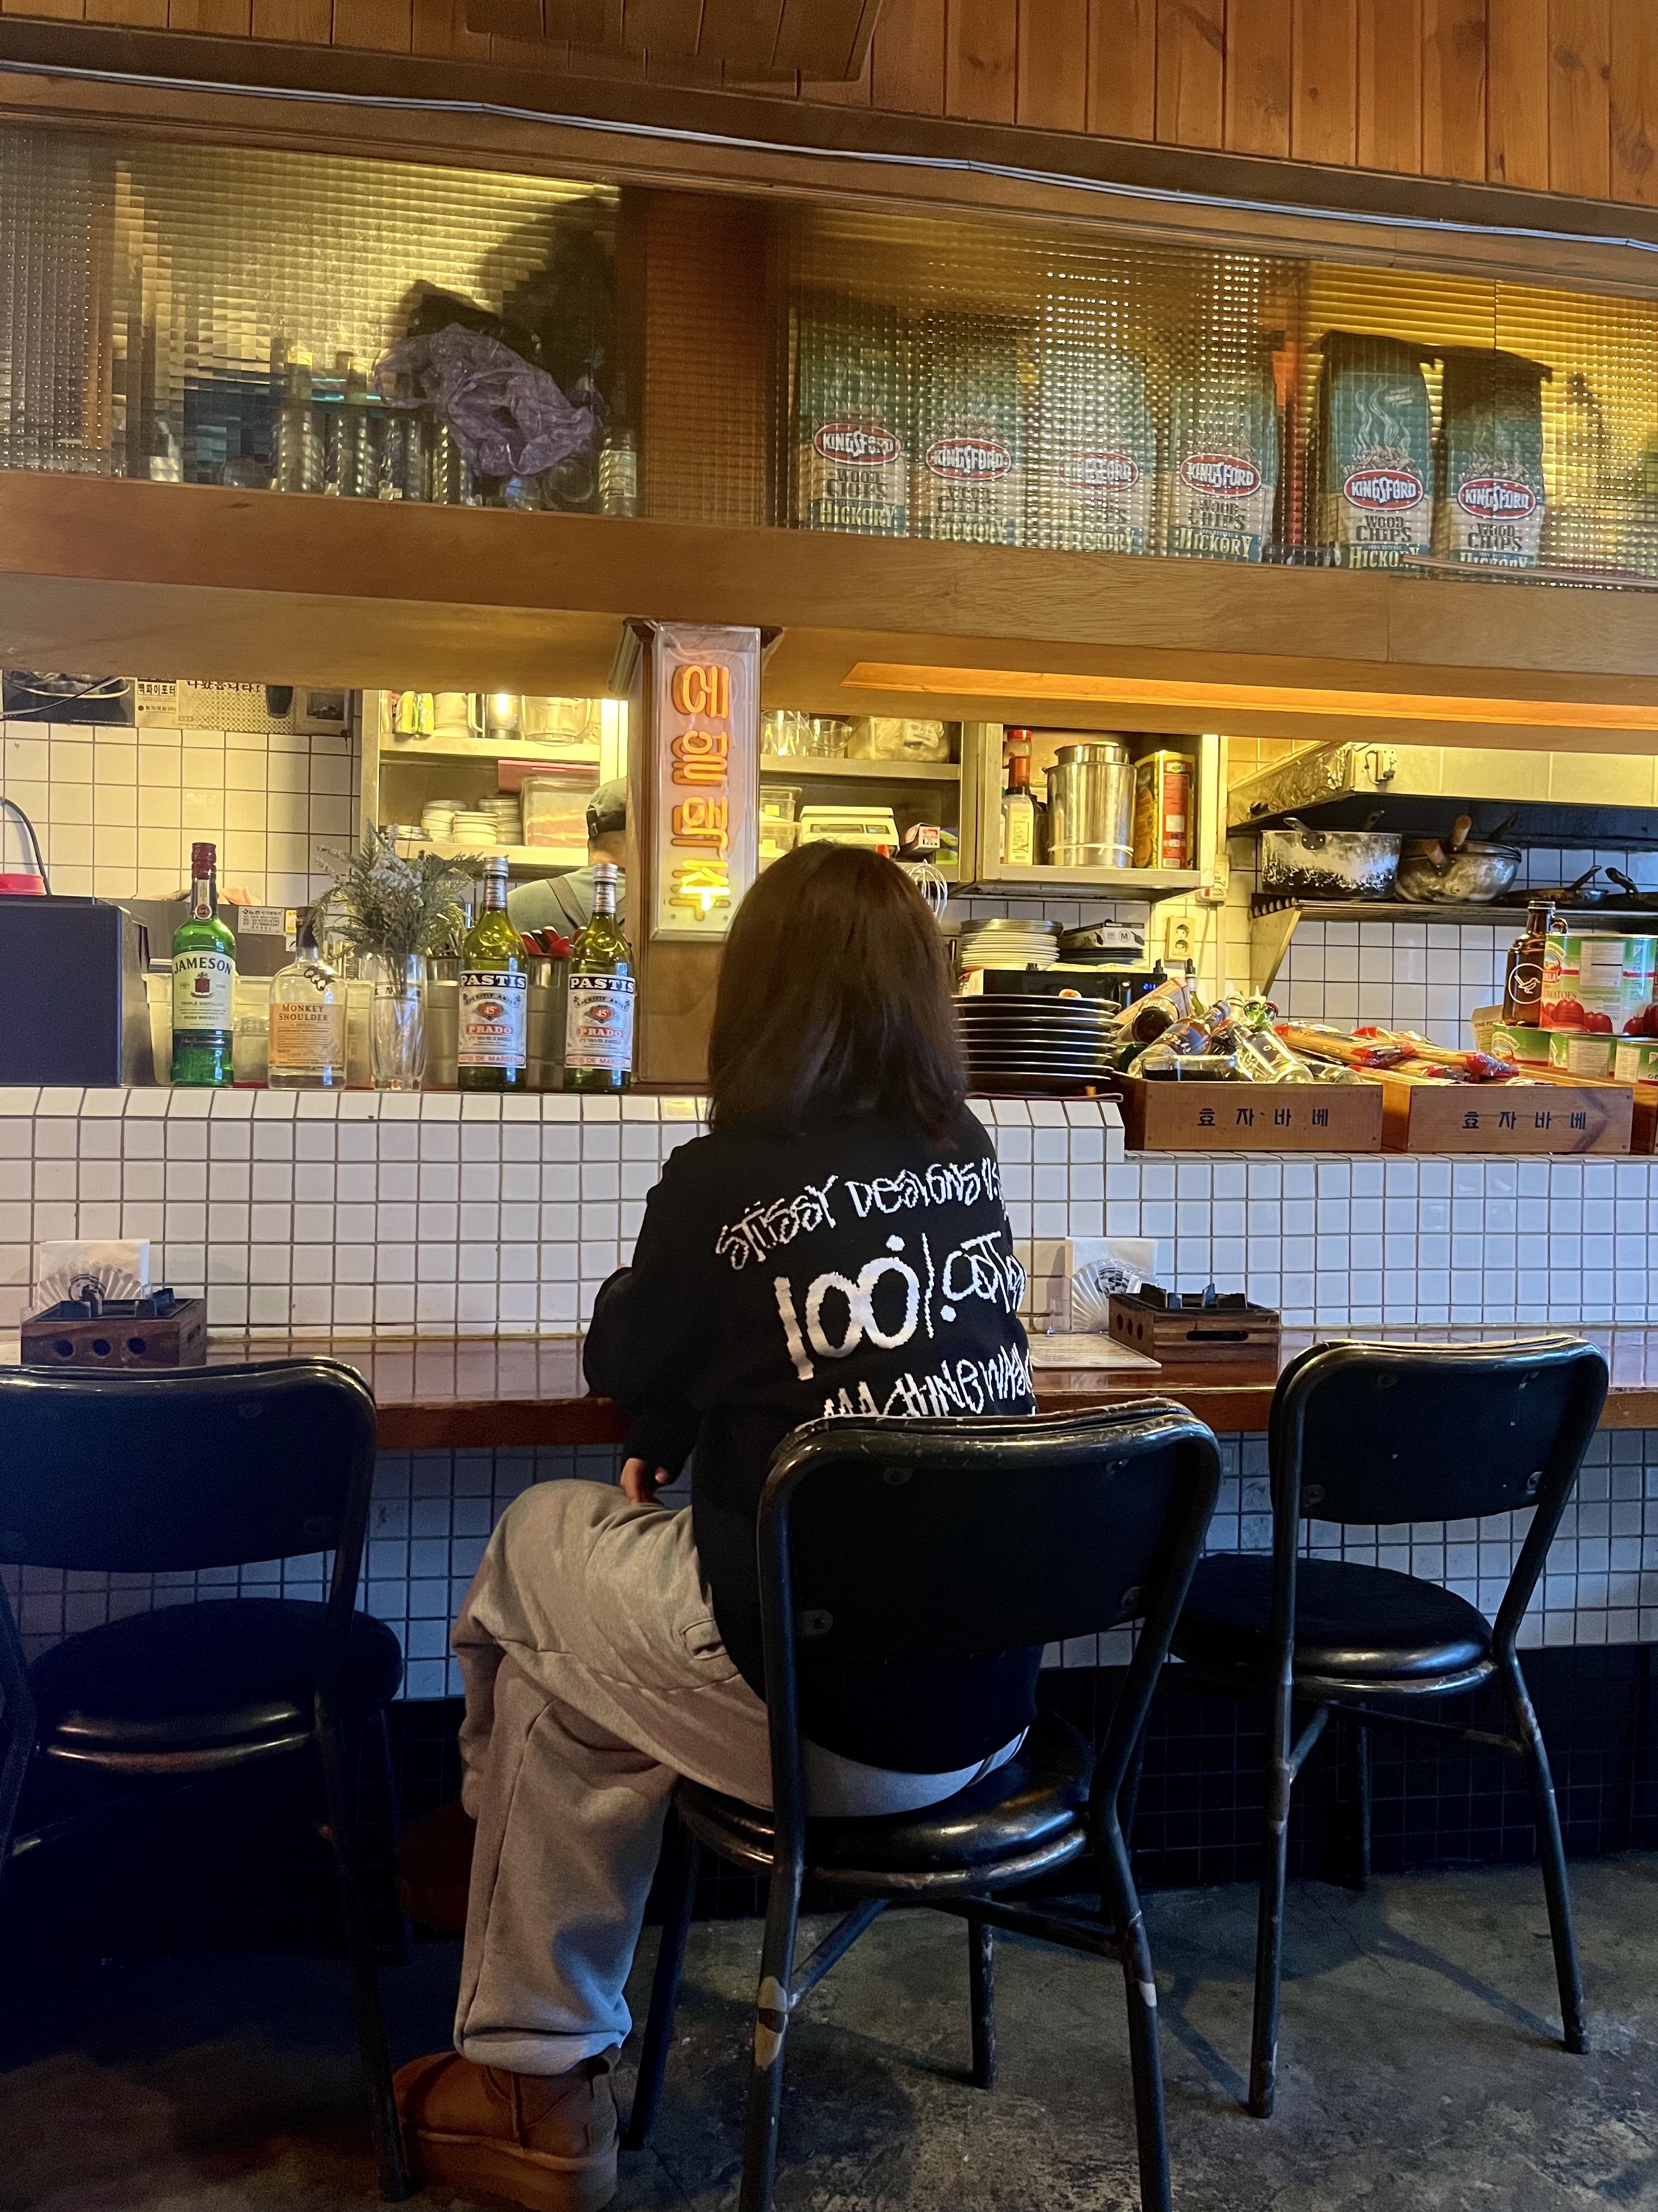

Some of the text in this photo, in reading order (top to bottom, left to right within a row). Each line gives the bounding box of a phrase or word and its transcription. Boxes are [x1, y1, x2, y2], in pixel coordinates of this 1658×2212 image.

[823, 430, 895, 458] KINGSFORD
[933, 445, 1005, 473] KINGSFORD
[1187, 461, 1254, 488] KINGSFORD
[1351, 476, 1417, 503] KINGSFORD
[1465, 485, 1529, 512] KINGSFORD
[819, 500, 896, 528] HICKORY
[1199, 499, 1239, 515] WOOD
[1189, 507, 1245, 530] CHIPS
[1365, 515, 1405, 529] WOOD
[931, 517, 1008, 544] HICKORY
[1356, 525, 1412, 542] CHIPS
[1477, 522, 1516, 538] WOOD
[1175, 527, 1253, 557] HICKORY
[1468, 532, 1523, 550] CHIPS
[679, 665, 731, 911] 에일맥주
[174, 957, 232, 975] JAMESON
[461, 974, 525, 989] PASTIS
[570, 978, 635, 994] PASTIS
[279, 1013, 329, 1021] SHOULDER
[282, 1004, 324, 1013] MONKEY
[468, 1025, 512, 1034] PRADO
[579, 1028, 623, 1037] PRADO
